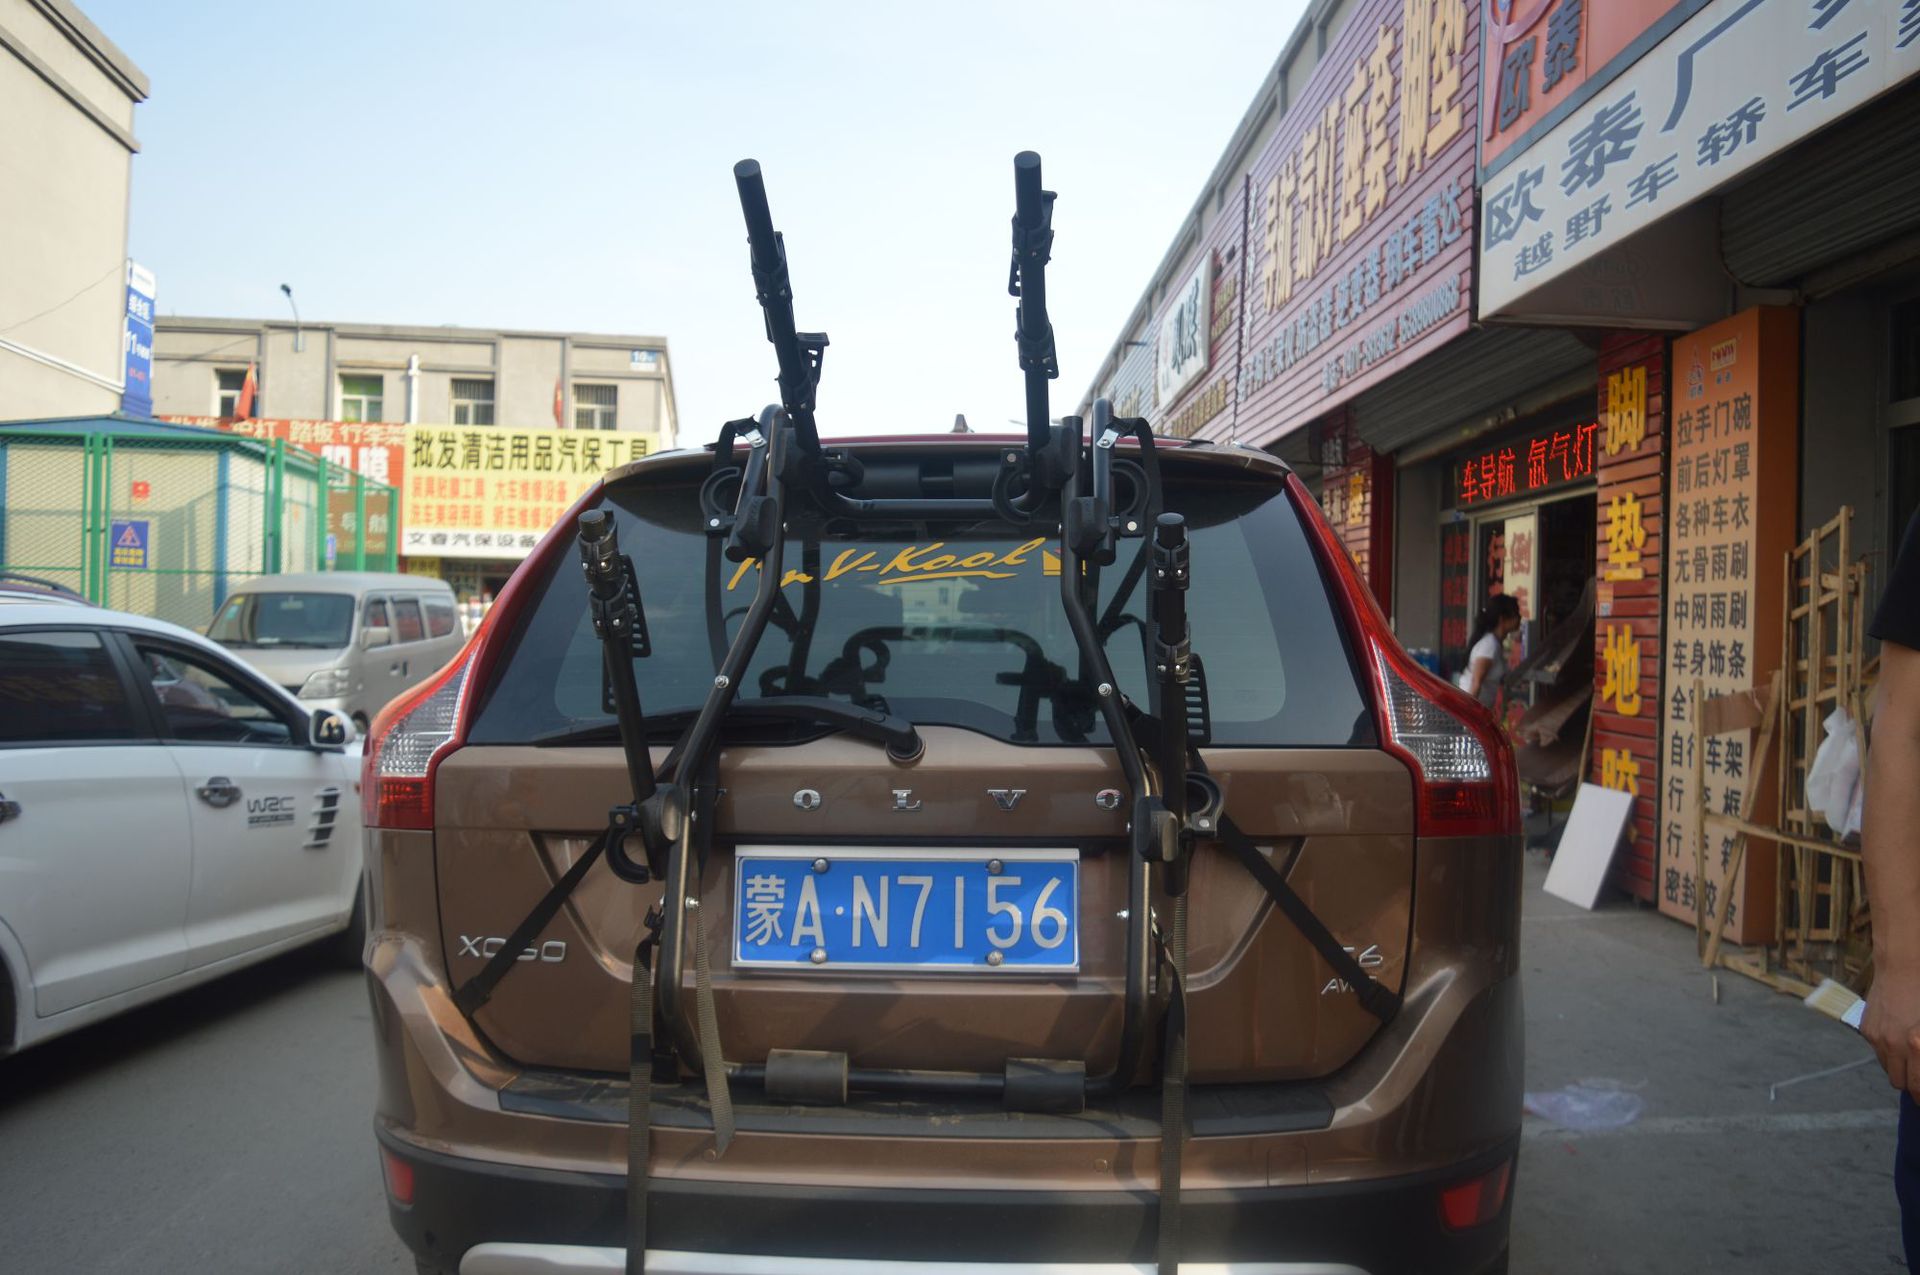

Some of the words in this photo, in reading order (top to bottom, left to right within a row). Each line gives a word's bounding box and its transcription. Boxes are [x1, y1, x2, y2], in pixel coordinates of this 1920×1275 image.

[1484, 0, 1856, 253] 欧泰厂
[1676, 391, 1752, 449] 拉手门碗
[412, 430, 649, 477] 批发清洁用品汽保工具
[1461, 447, 1517, 504] 车导航
[1526, 422, 1599, 490] 氙气灯
[1676, 442, 1751, 493] 前后灯罩
[1675, 492, 1750, 539] 各种车衣
[1674, 541, 1749, 585] 无骨雨刷
[1673, 590, 1748, 630] 中网雨刷
[1672, 640, 1746, 679] 车身饰条
[247, 797, 295, 813] WRC
